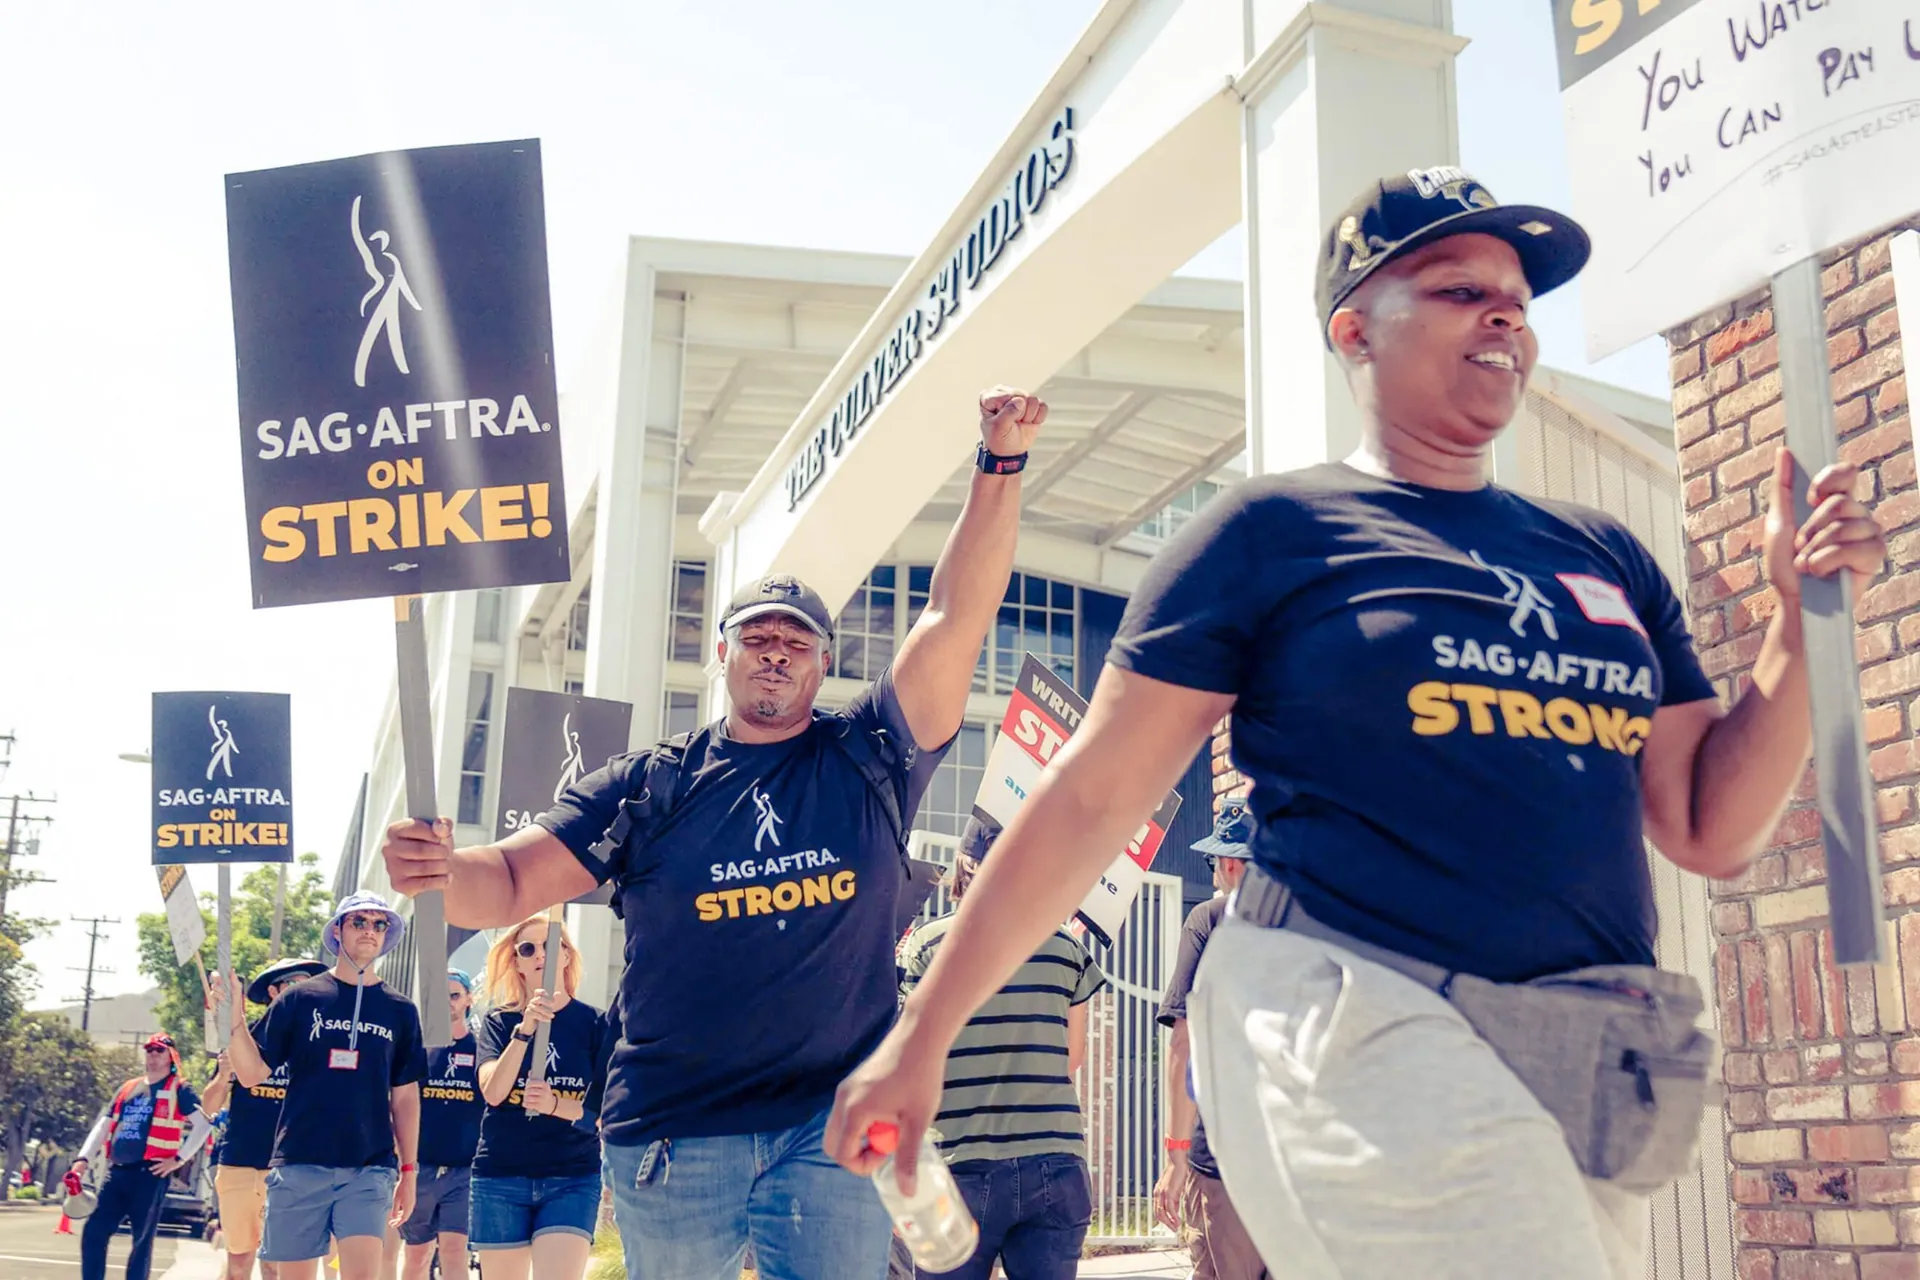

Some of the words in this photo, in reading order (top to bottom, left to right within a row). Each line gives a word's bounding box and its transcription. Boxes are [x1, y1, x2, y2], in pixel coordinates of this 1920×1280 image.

[1717, 102, 1782, 149] CAN
[1817, 47, 1875, 98] PAY
[786, 427, 826, 512] THE
[830, 309, 923, 459] CULVER
[926, 106, 1076, 341] STUDIOS
[367, 457, 424, 490] ON
[260, 482, 553, 563] STRIKE!
[156, 822, 289, 848] STRIKE!
[209, 808, 236, 821] ON
[695, 870, 857, 922] STRONG
[422, 1086, 475, 1102] STRONG
